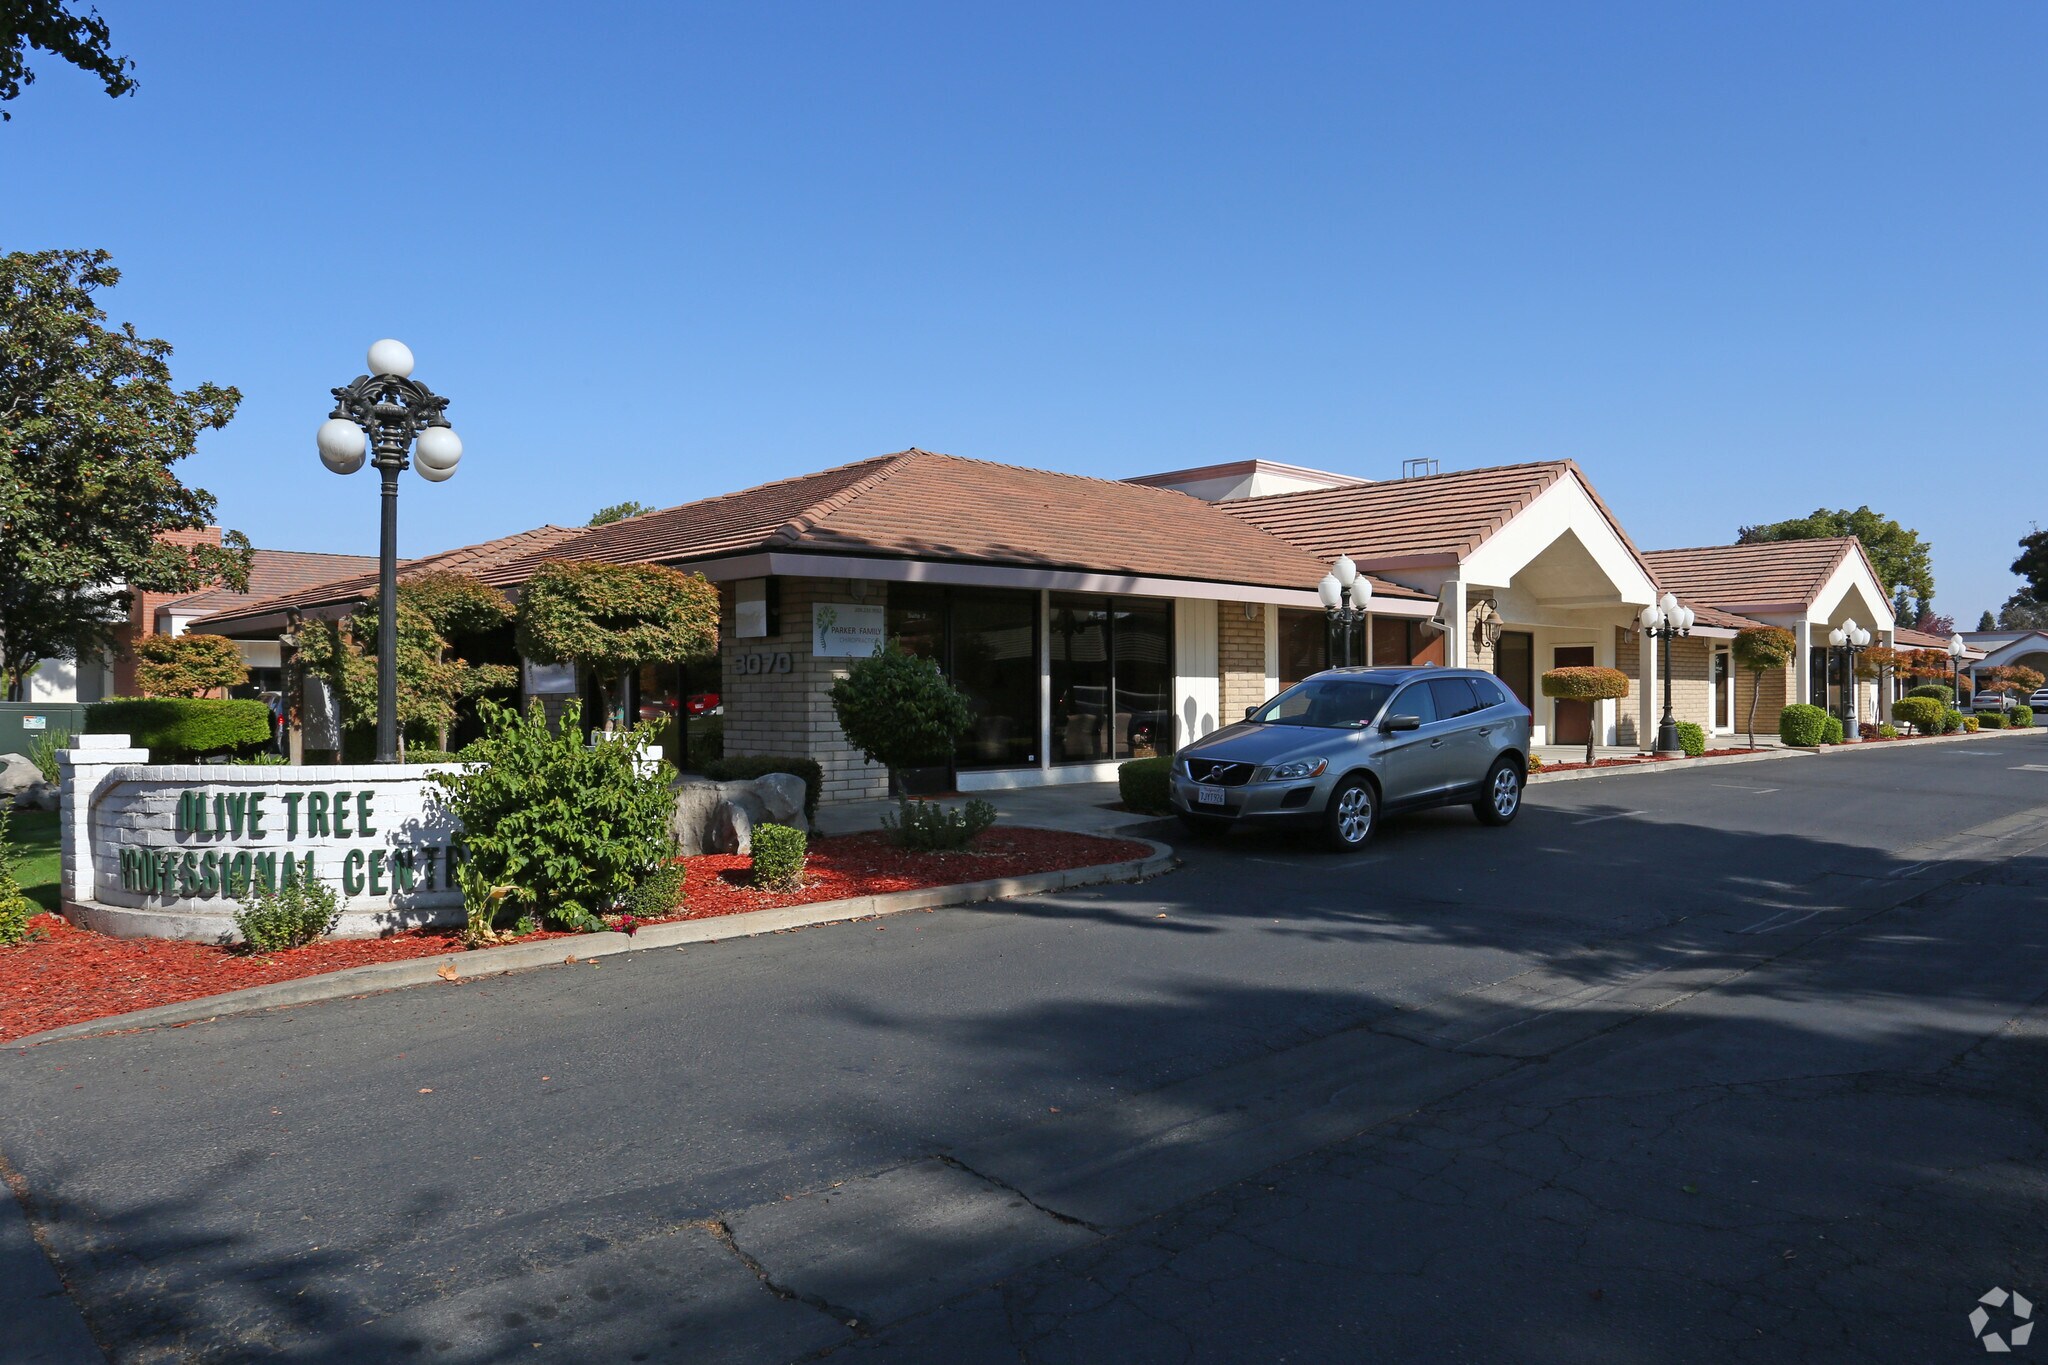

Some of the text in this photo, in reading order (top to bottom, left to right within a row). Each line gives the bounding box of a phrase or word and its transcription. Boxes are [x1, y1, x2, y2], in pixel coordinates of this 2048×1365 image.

[831, 626, 881, 635] PARKER FAMILY
[733, 652, 792, 674] 3070
[180, 790, 377, 838] OLIVE TREE
